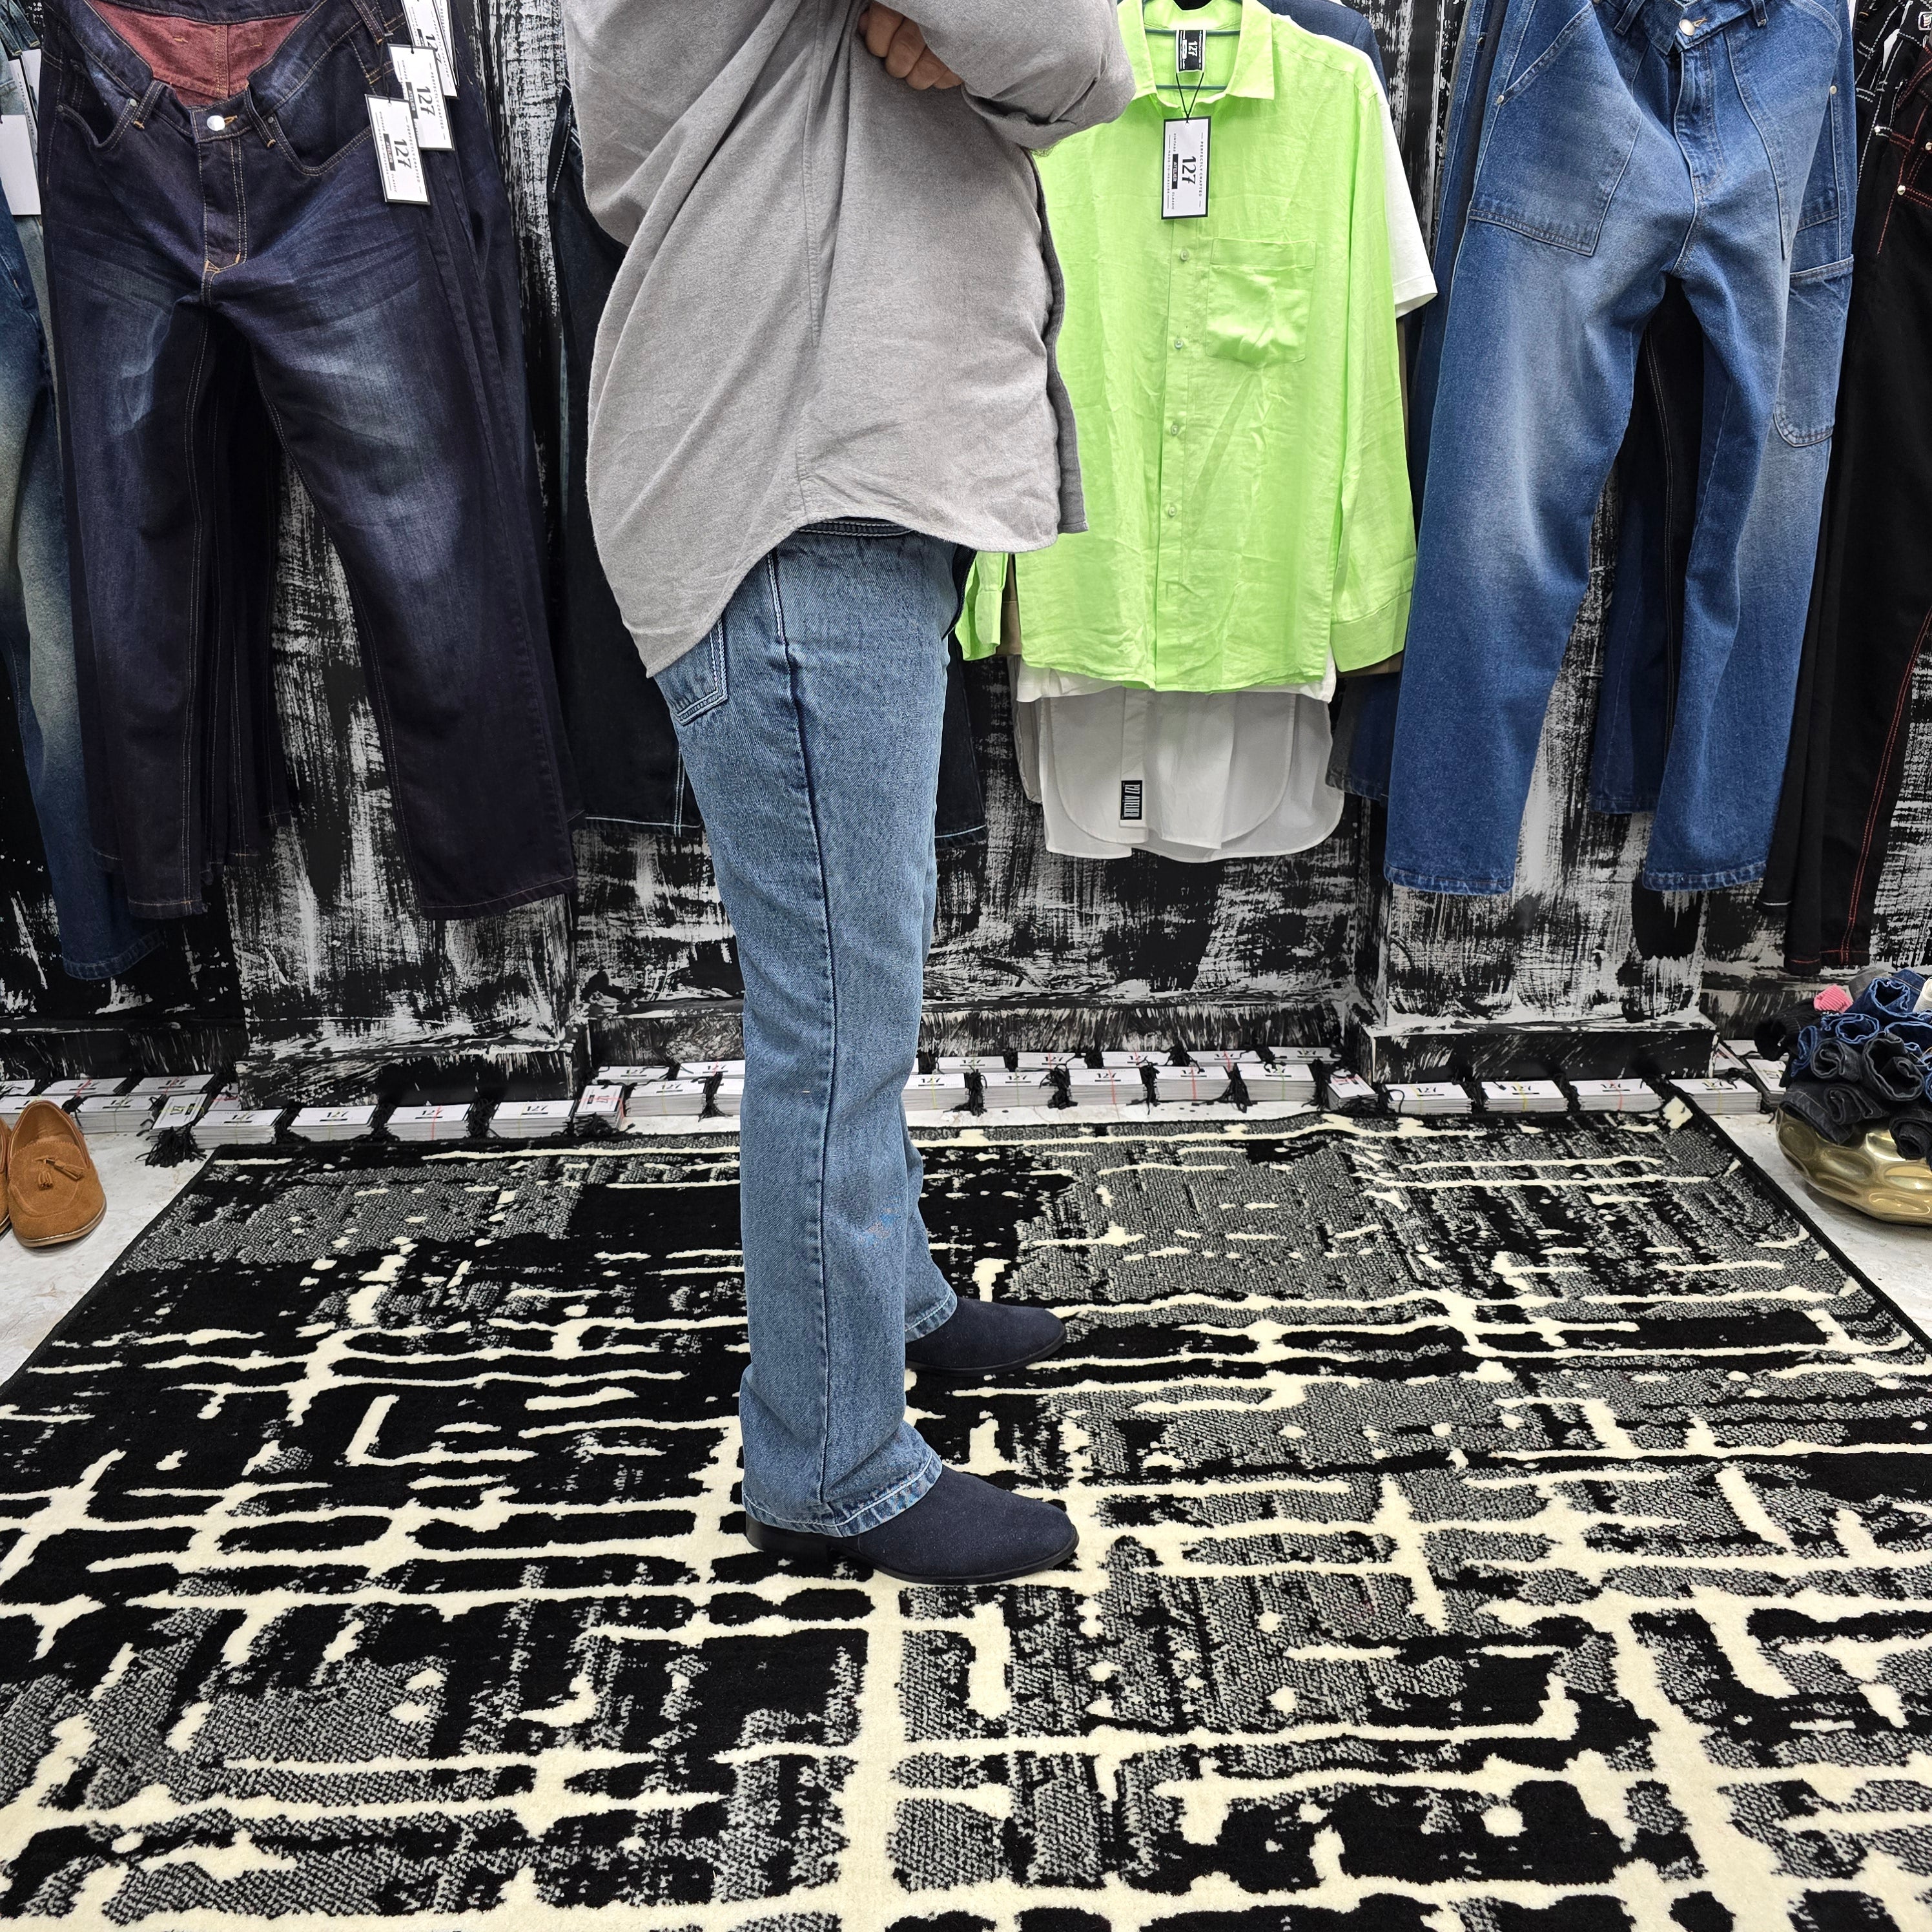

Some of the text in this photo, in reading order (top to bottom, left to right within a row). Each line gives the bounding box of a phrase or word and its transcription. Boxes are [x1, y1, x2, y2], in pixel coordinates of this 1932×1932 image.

[1188, 41, 1198, 57] 127
[407, 90, 416, 111] ATELIER
[416, 86, 436, 116] 127
[431, 72, 440, 103] PERFECTLY
[394, 139, 412, 169] 127
[406, 125, 416, 156] PERFECTLY
[1182, 156, 1197, 185] 127
[1124, 784, 1140, 817] 127 ATELIER
